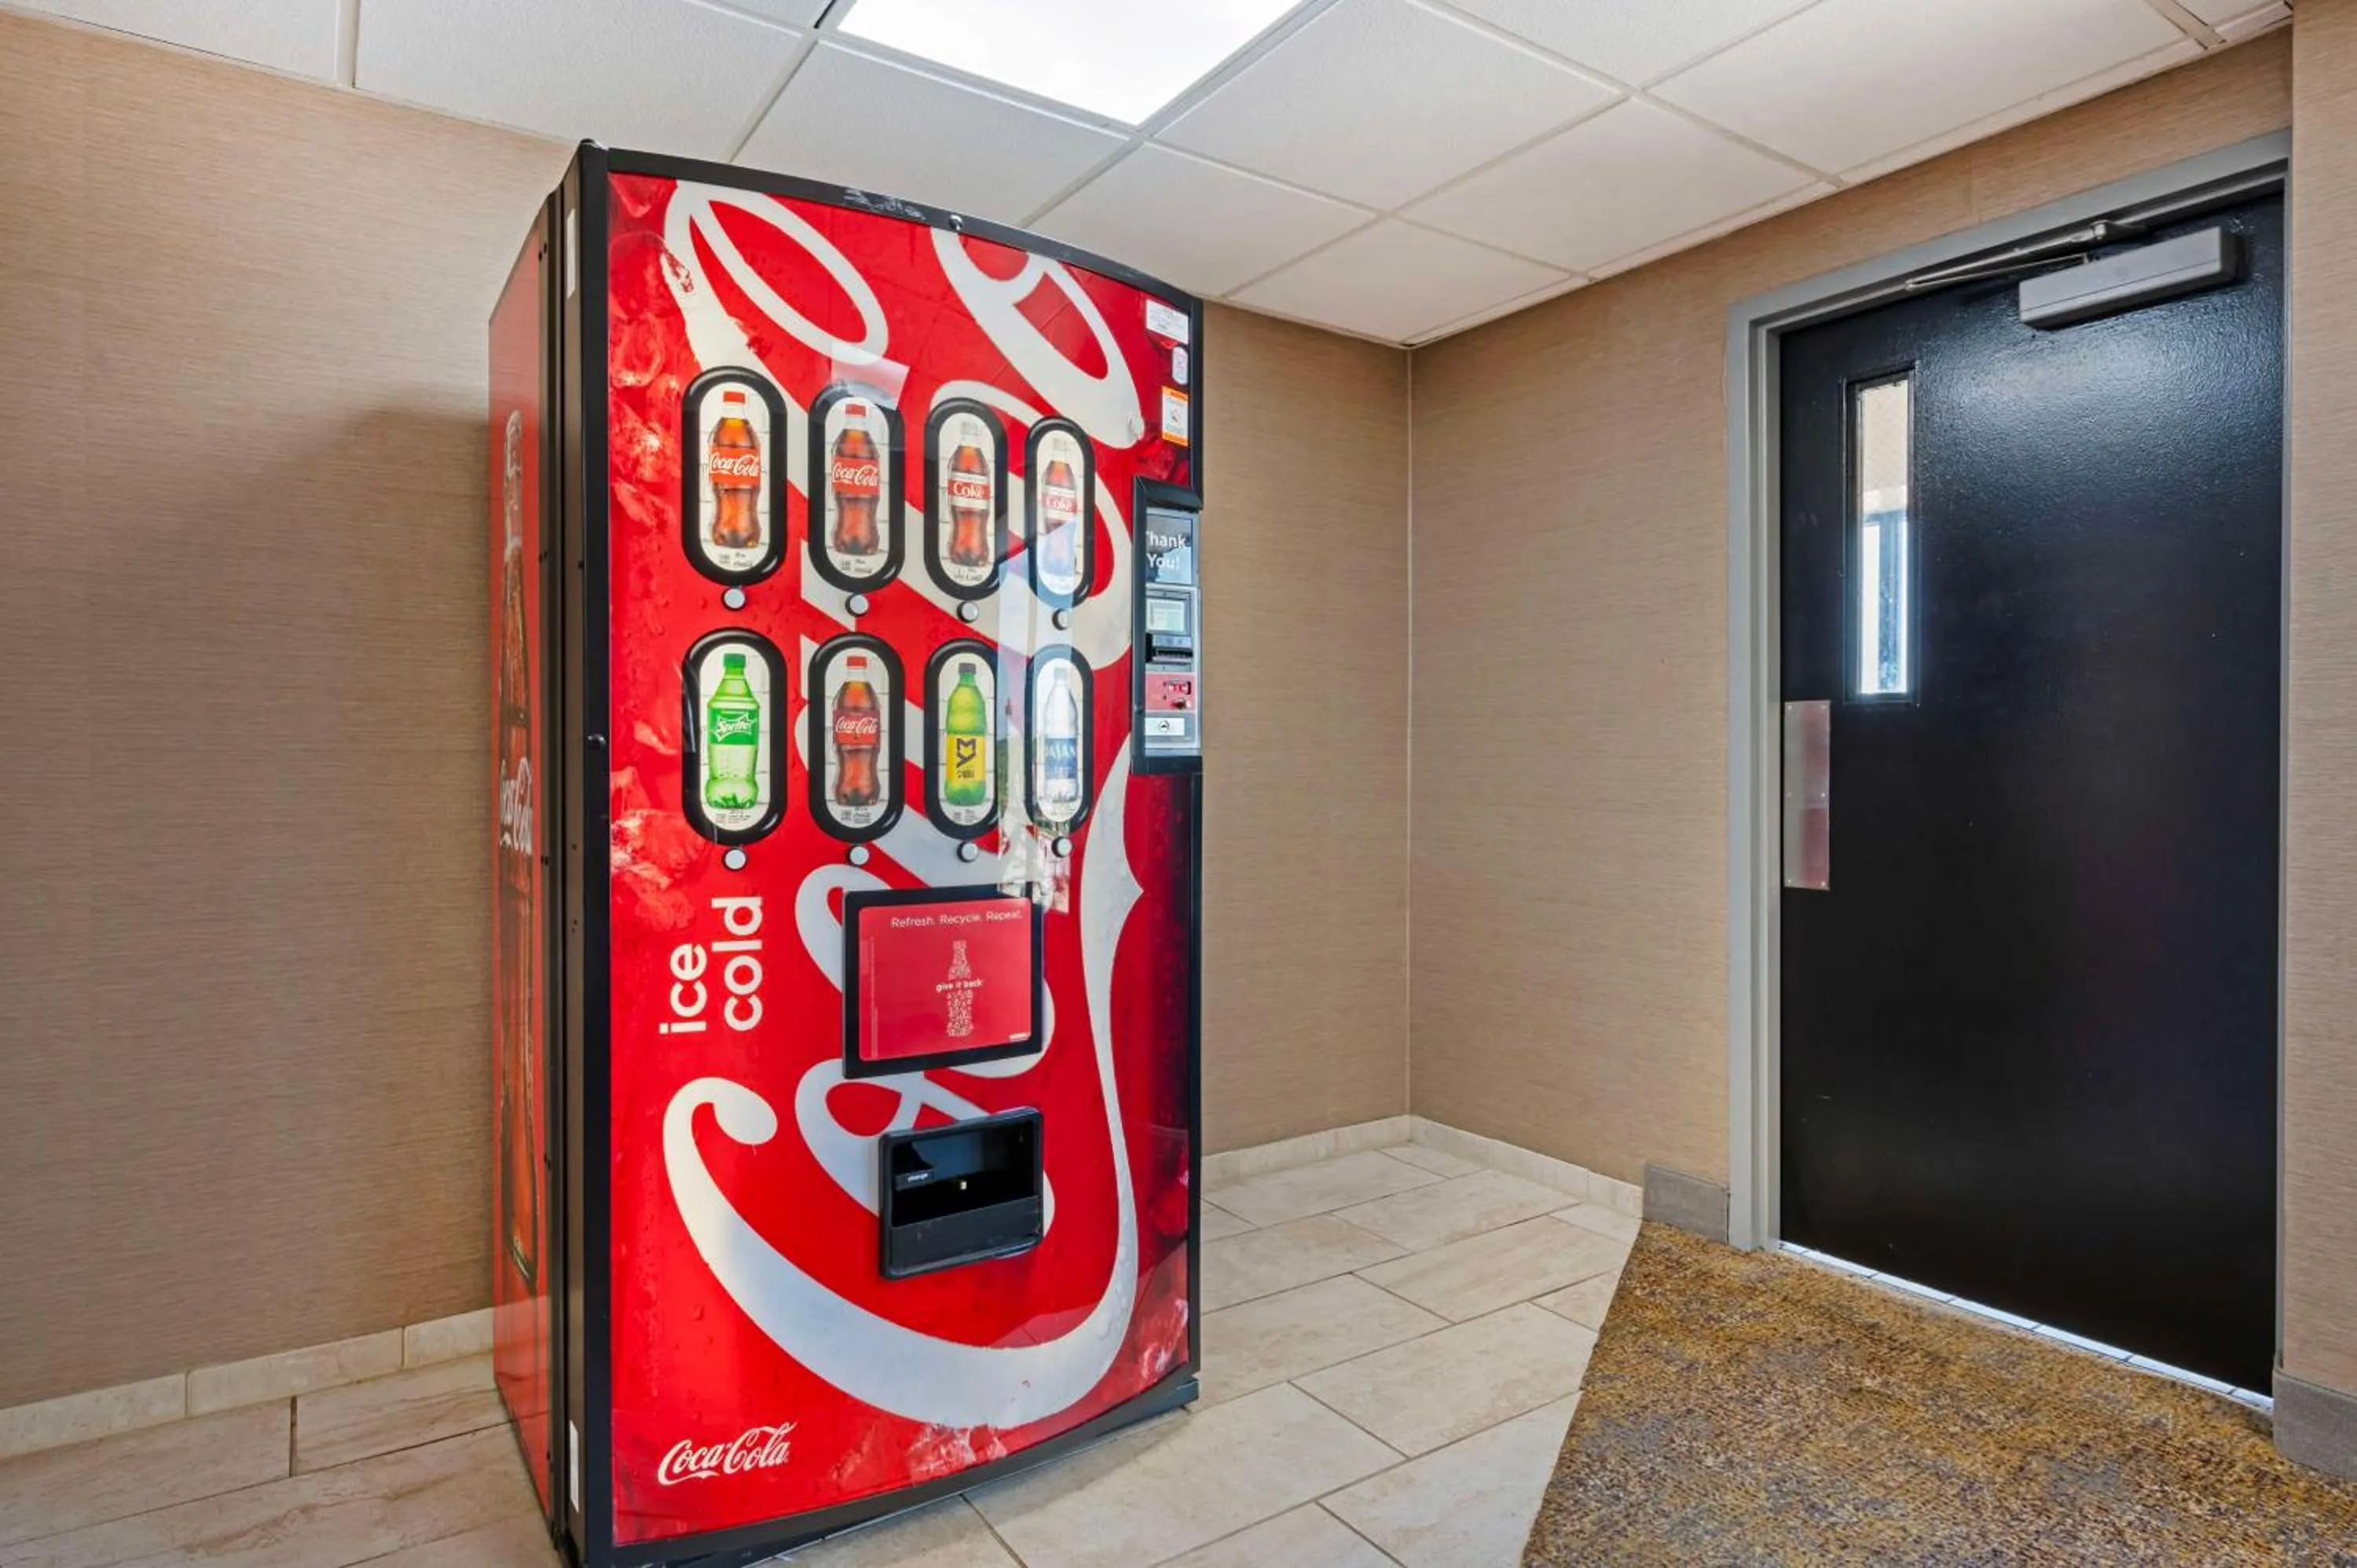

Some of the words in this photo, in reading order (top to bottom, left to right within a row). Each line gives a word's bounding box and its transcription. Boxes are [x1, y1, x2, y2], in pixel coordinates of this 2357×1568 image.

[709, 452, 760, 477] Coca-Cola
[833, 462, 879, 486] Coca-Cola
[953, 482, 984, 499] Coke
[1046, 496, 1073, 511] Coke
[1146, 530, 1186, 547] hank
[1147, 552, 1179, 570] You!
[717, 720, 752, 734] Sprite
[835, 716, 878, 735] Coca-Cola
[891, 916, 935, 929] Refresh.
[710, 896, 764, 1031] cold
[658, 943, 708, 1035] ice
[657, 1420, 798, 1486] Coca-Cola
